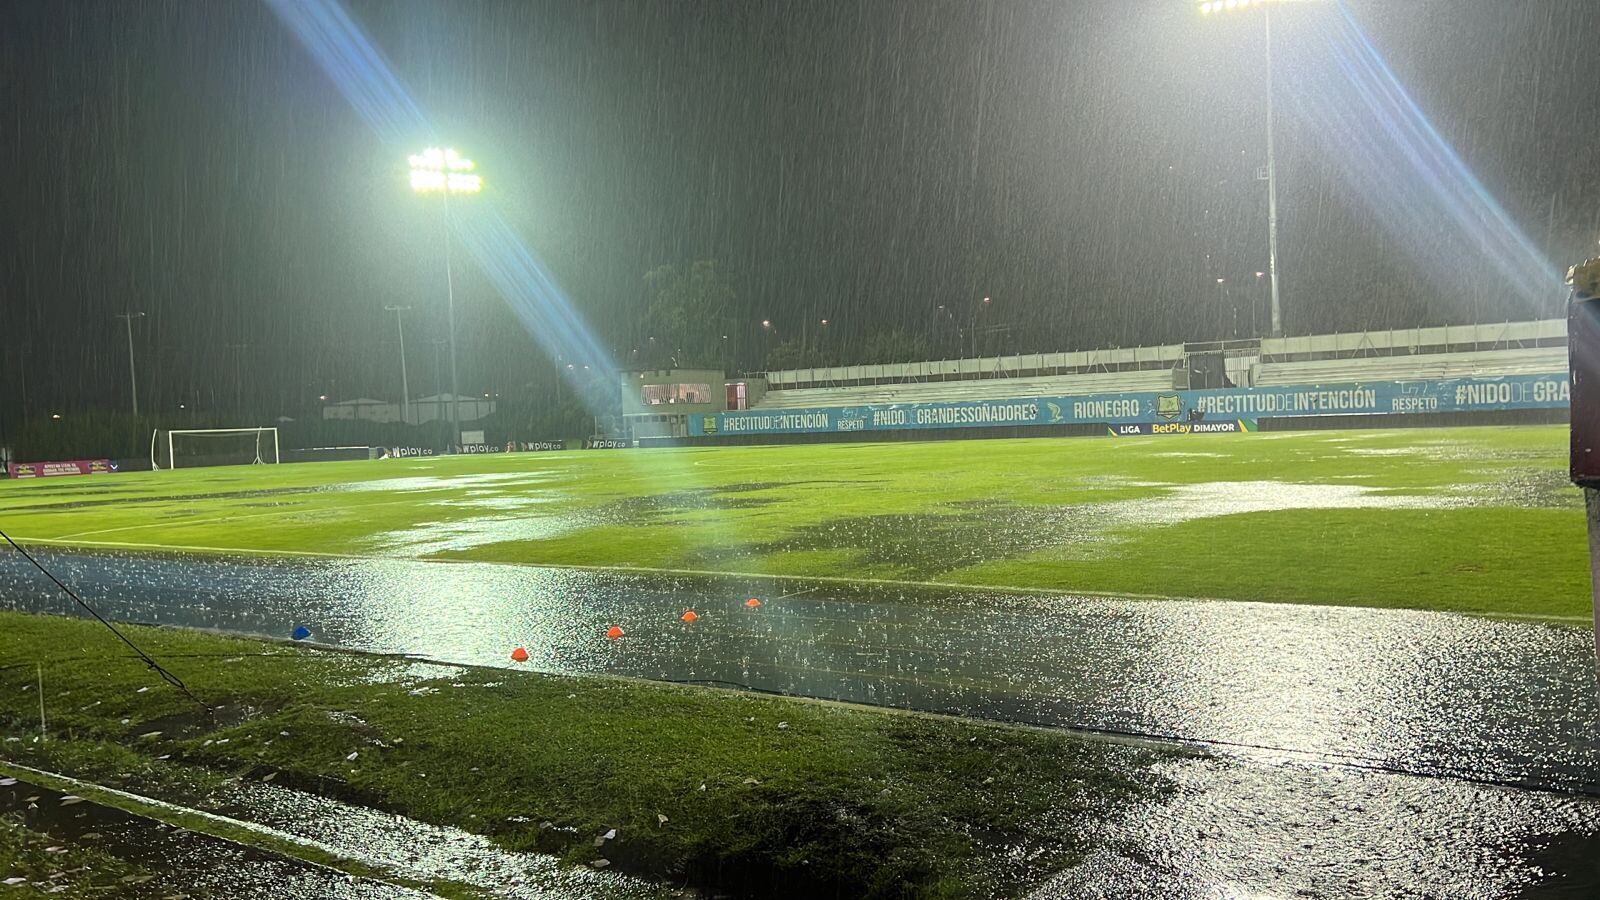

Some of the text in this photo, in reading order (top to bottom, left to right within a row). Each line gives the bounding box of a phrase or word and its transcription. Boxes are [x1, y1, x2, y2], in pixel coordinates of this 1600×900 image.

[1074, 400, 1139, 419] RIONEGRO
[1392, 397, 1438, 411] RESPETO
[837, 419, 864, 430] RESPETO
[1120, 422, 1235, 434] LIGA BetPlay DIMAYOR
